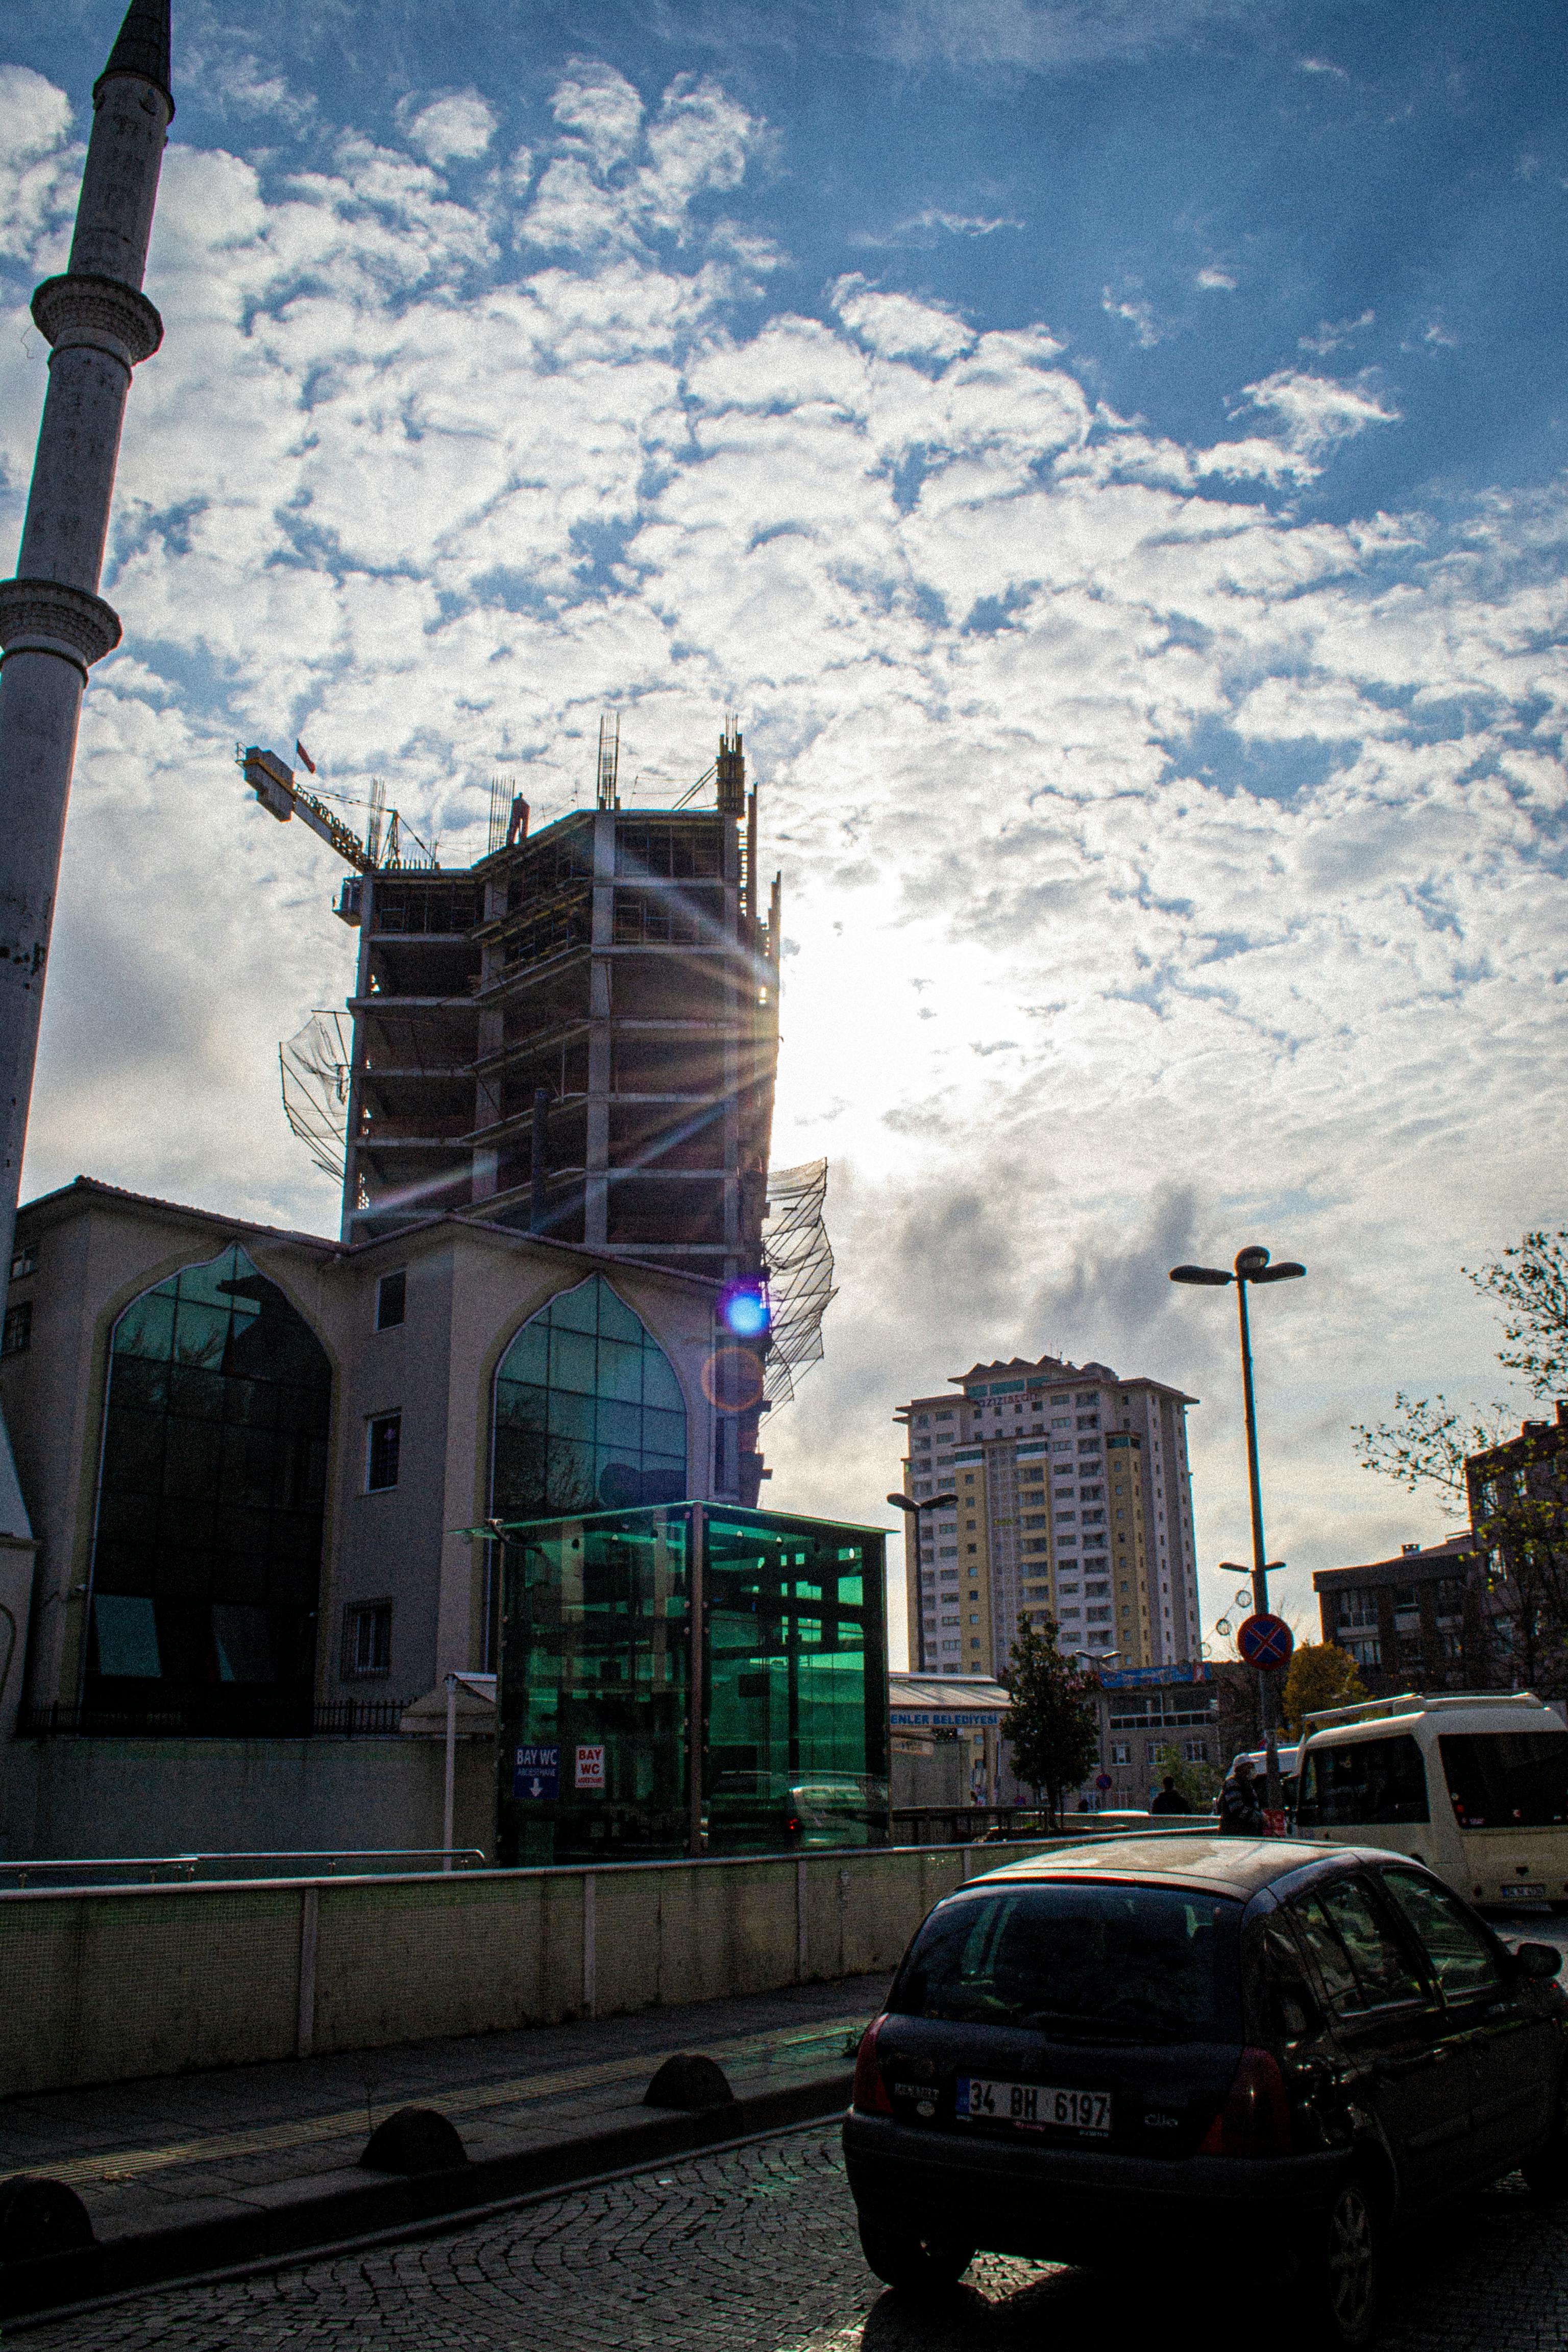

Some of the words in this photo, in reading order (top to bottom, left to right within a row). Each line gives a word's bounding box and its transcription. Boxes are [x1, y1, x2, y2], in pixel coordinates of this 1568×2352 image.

[517, 1748, 537, 1765] BAY
[540, 1749, 557, 1766] WC
[579, 1750, 602, 1760] BAY
[581, 1763, 600, 1775] WC
[971, 2082, 995, 2113] 34
[1011, 2087, 1037, 2120] BH
[1055, 2092, 1107, 2126] 6197
